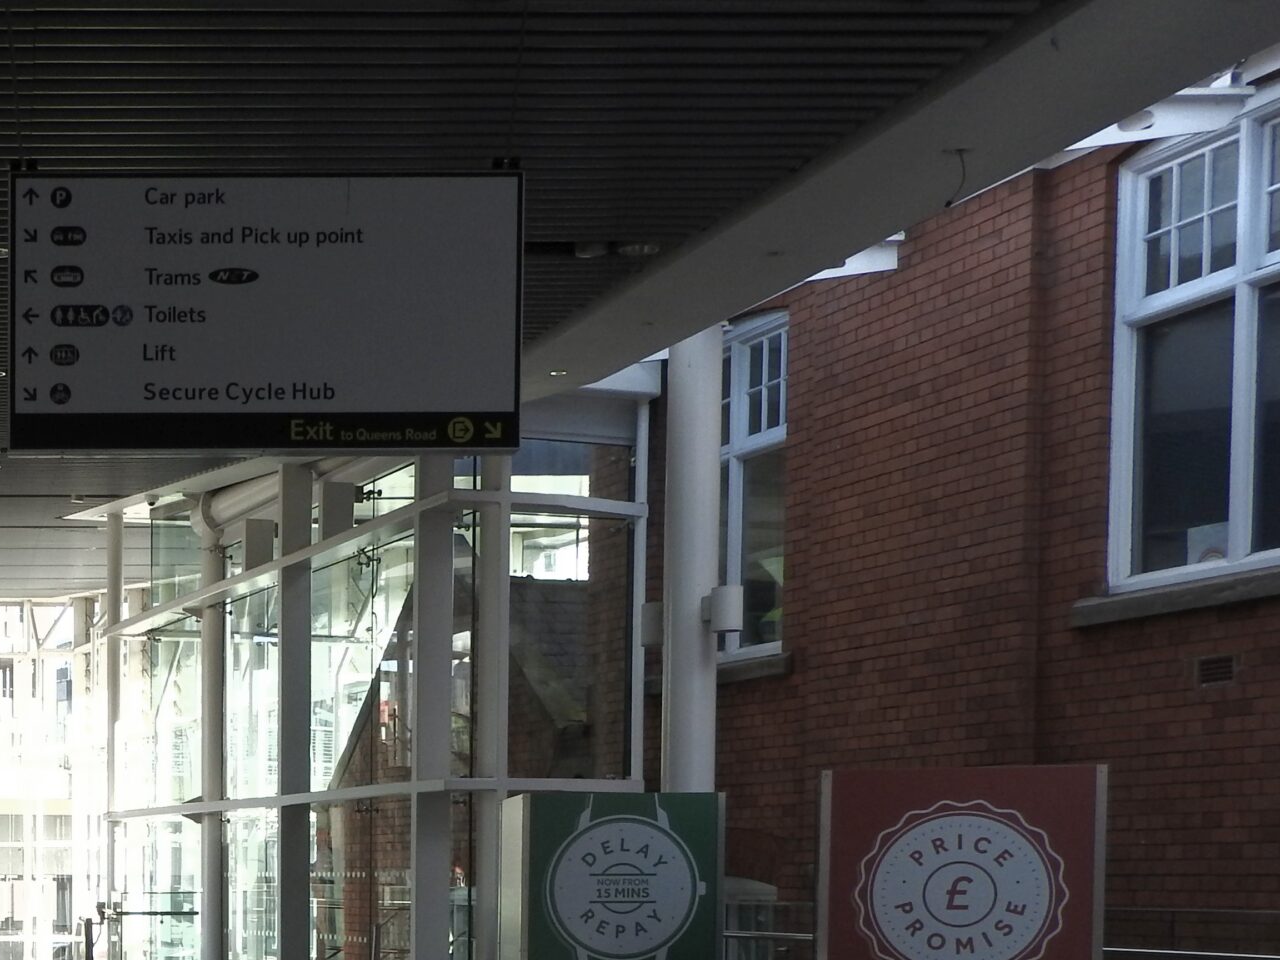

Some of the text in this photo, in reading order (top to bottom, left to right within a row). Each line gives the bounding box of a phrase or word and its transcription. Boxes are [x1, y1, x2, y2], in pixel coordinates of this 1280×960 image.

[144, 187, 226, 208] Car park
[144, 226, 364, 248] Taxis and Pick up point
[144, 268, 201, 286] Trams
[144, 306, 206, 323] Toilets
[142, 343, 176, 361] Lift
[144, 382, 335, 404] Secure Cycle Hub
[289, 418, 437, 441] Exit to Queens Road
[581, 838, 668, 868] DELAY
[909, 834, 1014, 867] PRICE
[597, 878, 649, 886] NOW FROM
[946, 876, 973, 910] £
[596, 888, 650, 899] 15 MINS
[580, 908, 662, 939] REPAY
[894, 901, 1027, 955] PROMISE
